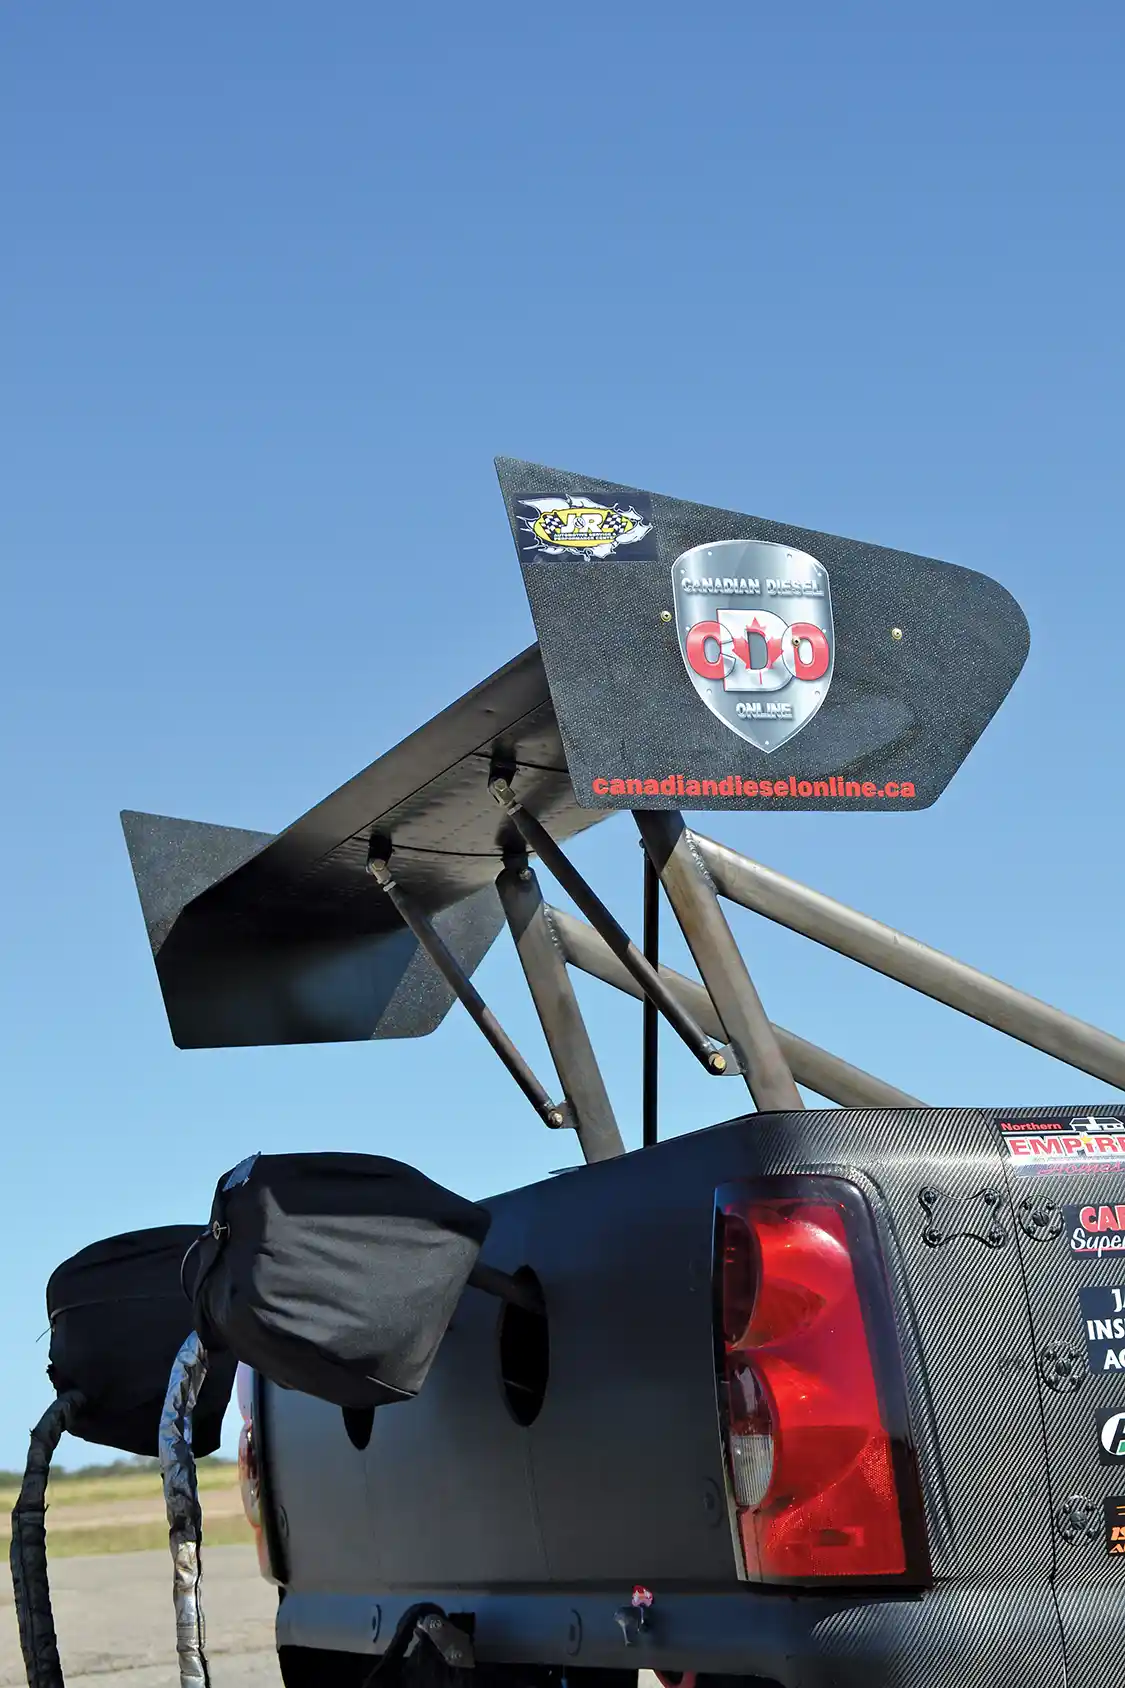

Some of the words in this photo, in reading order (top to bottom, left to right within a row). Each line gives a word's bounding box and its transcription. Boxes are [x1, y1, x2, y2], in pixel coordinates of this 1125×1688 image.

[561, 513, 603, 533] J&R
[681, 577, 760, 595] CANADIAN
[766, 578, 824, 597] DIESEL
[686, 608, 830, 692] CDO
[735, 702, 794, 721] ONLINE
[592, 774, 916, 799] canadiandieselonline.ca
[1001, 1122, 1063, 1131] Northern
